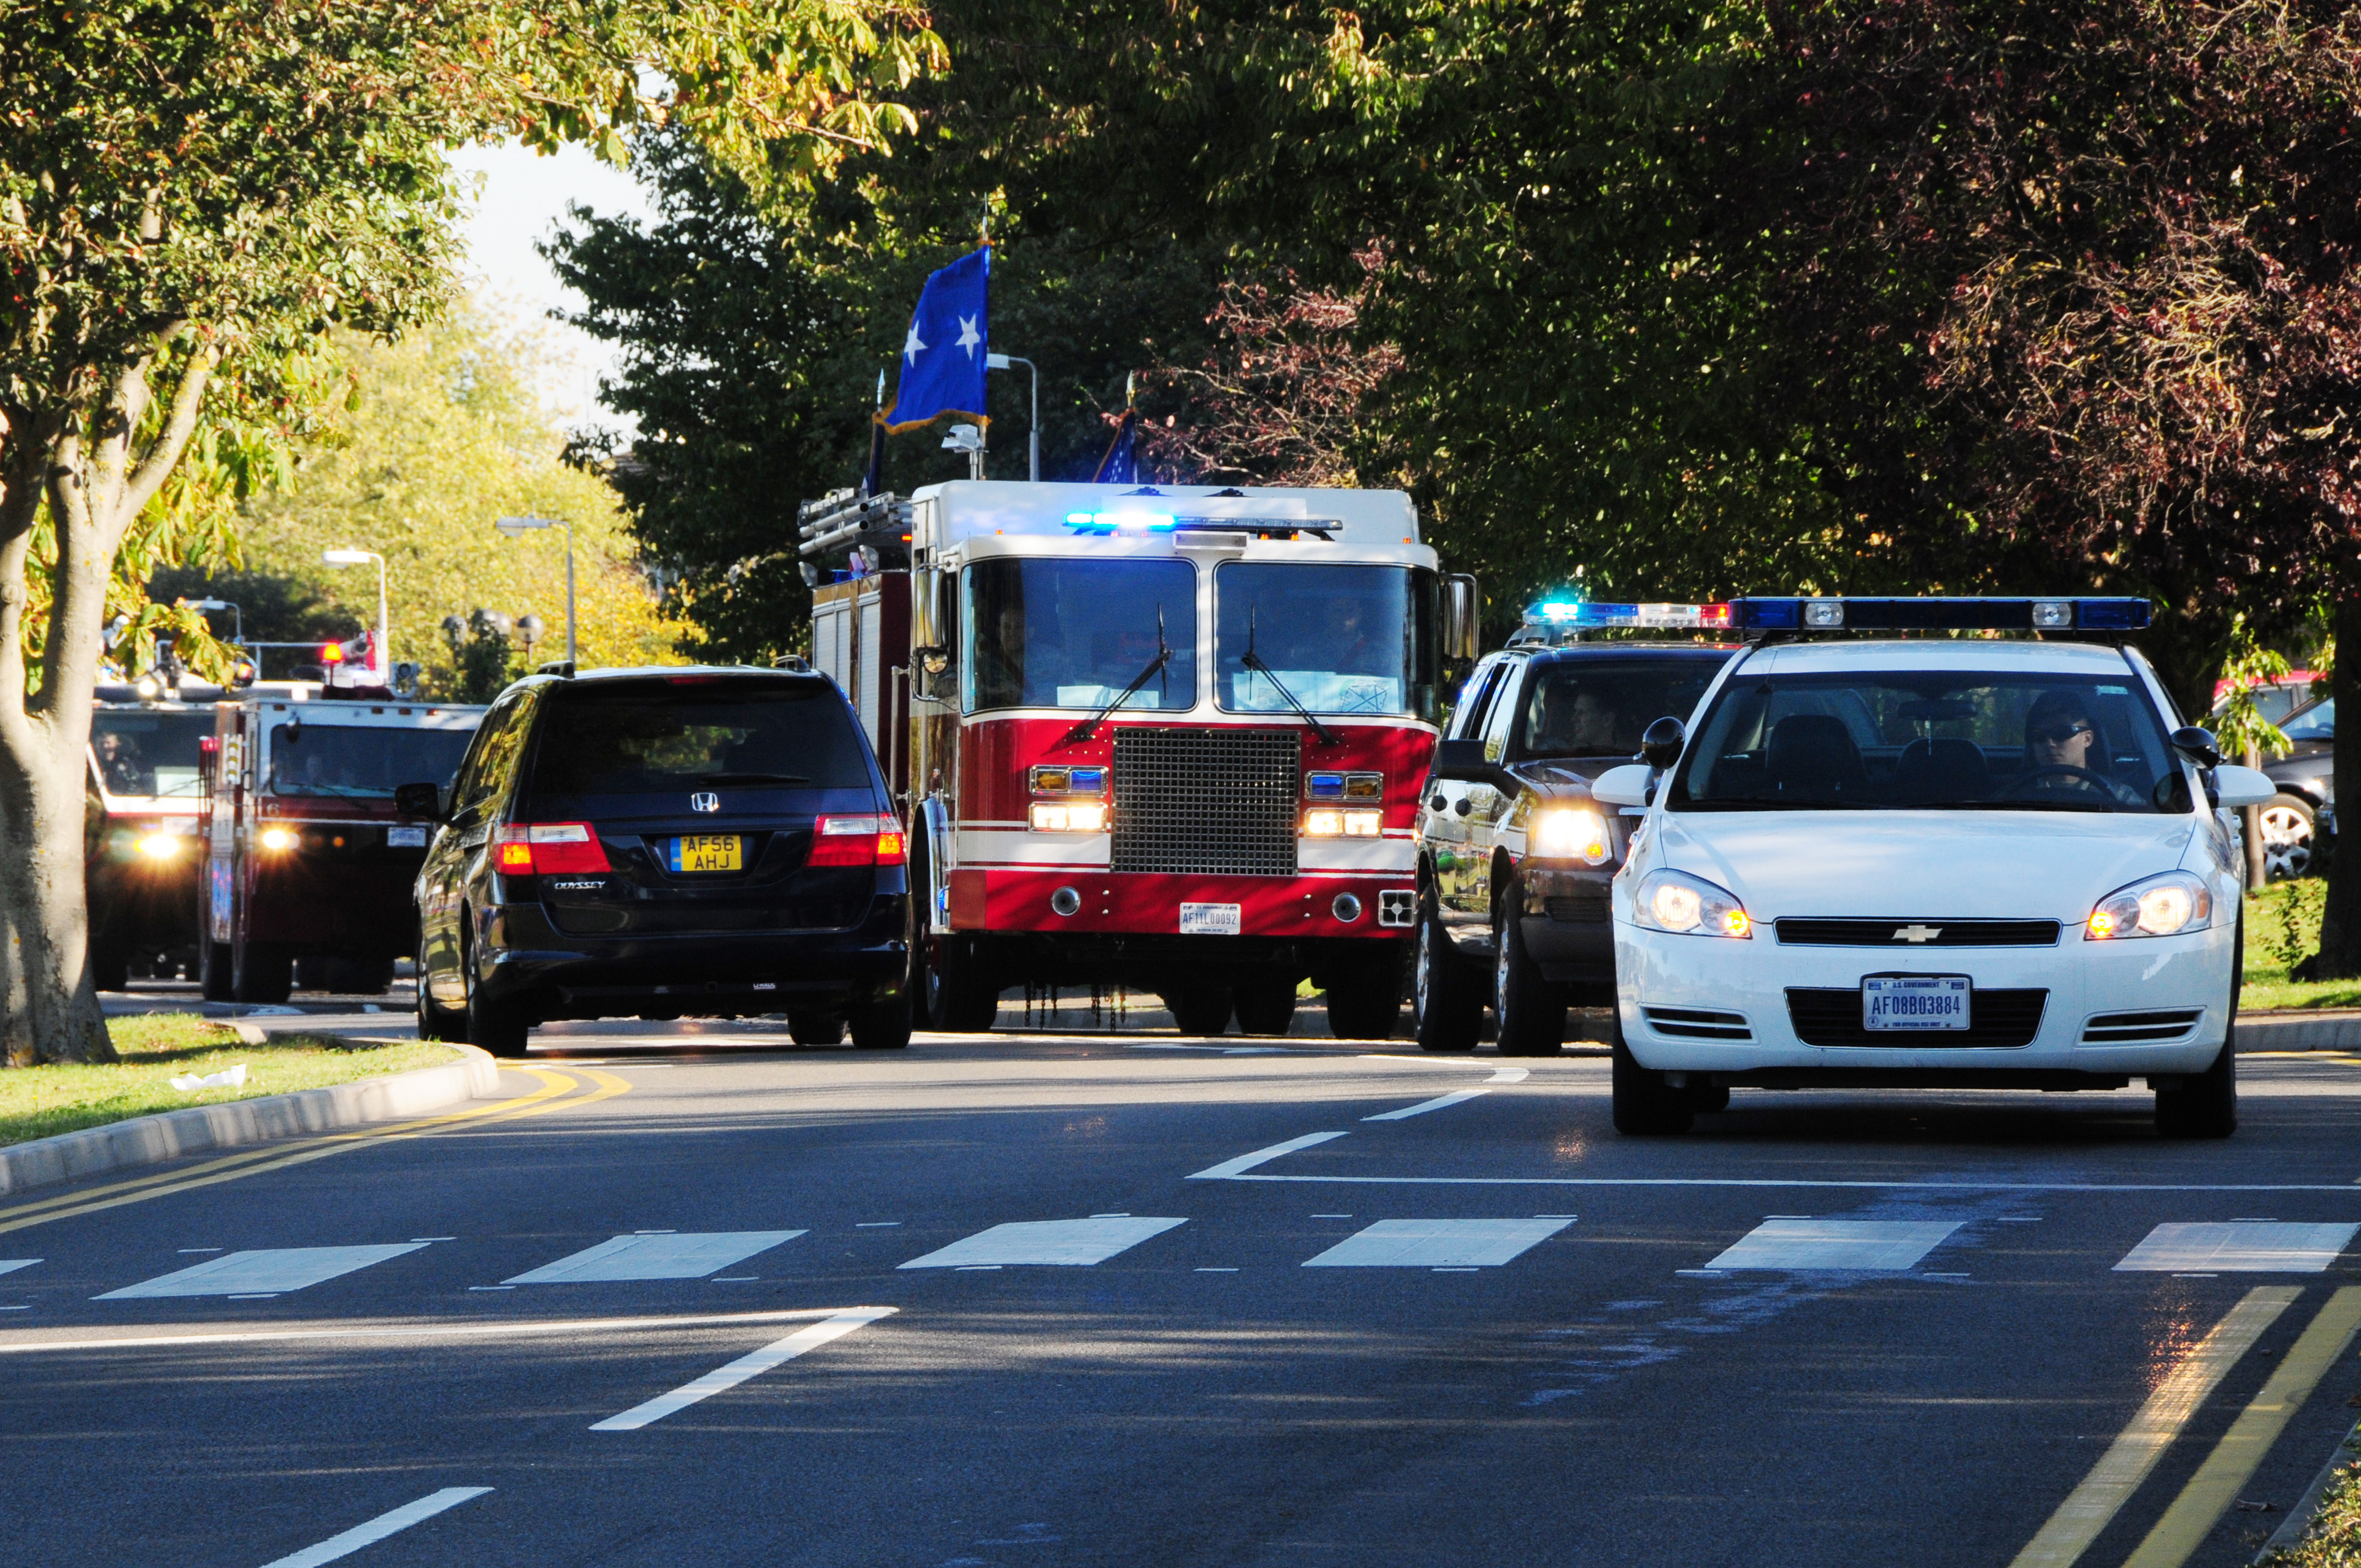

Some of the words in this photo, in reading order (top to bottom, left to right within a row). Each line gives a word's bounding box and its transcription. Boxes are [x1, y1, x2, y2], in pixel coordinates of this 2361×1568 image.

[687, 836, 735, 852] AF56
[694, 854, 730, 869] AHJ
[554, 881, 606, 889] ODYSSEY
[1182, 912, 1237, 925] AF11L00092
[1872, 996, 1961, 1015] AF08B03884
